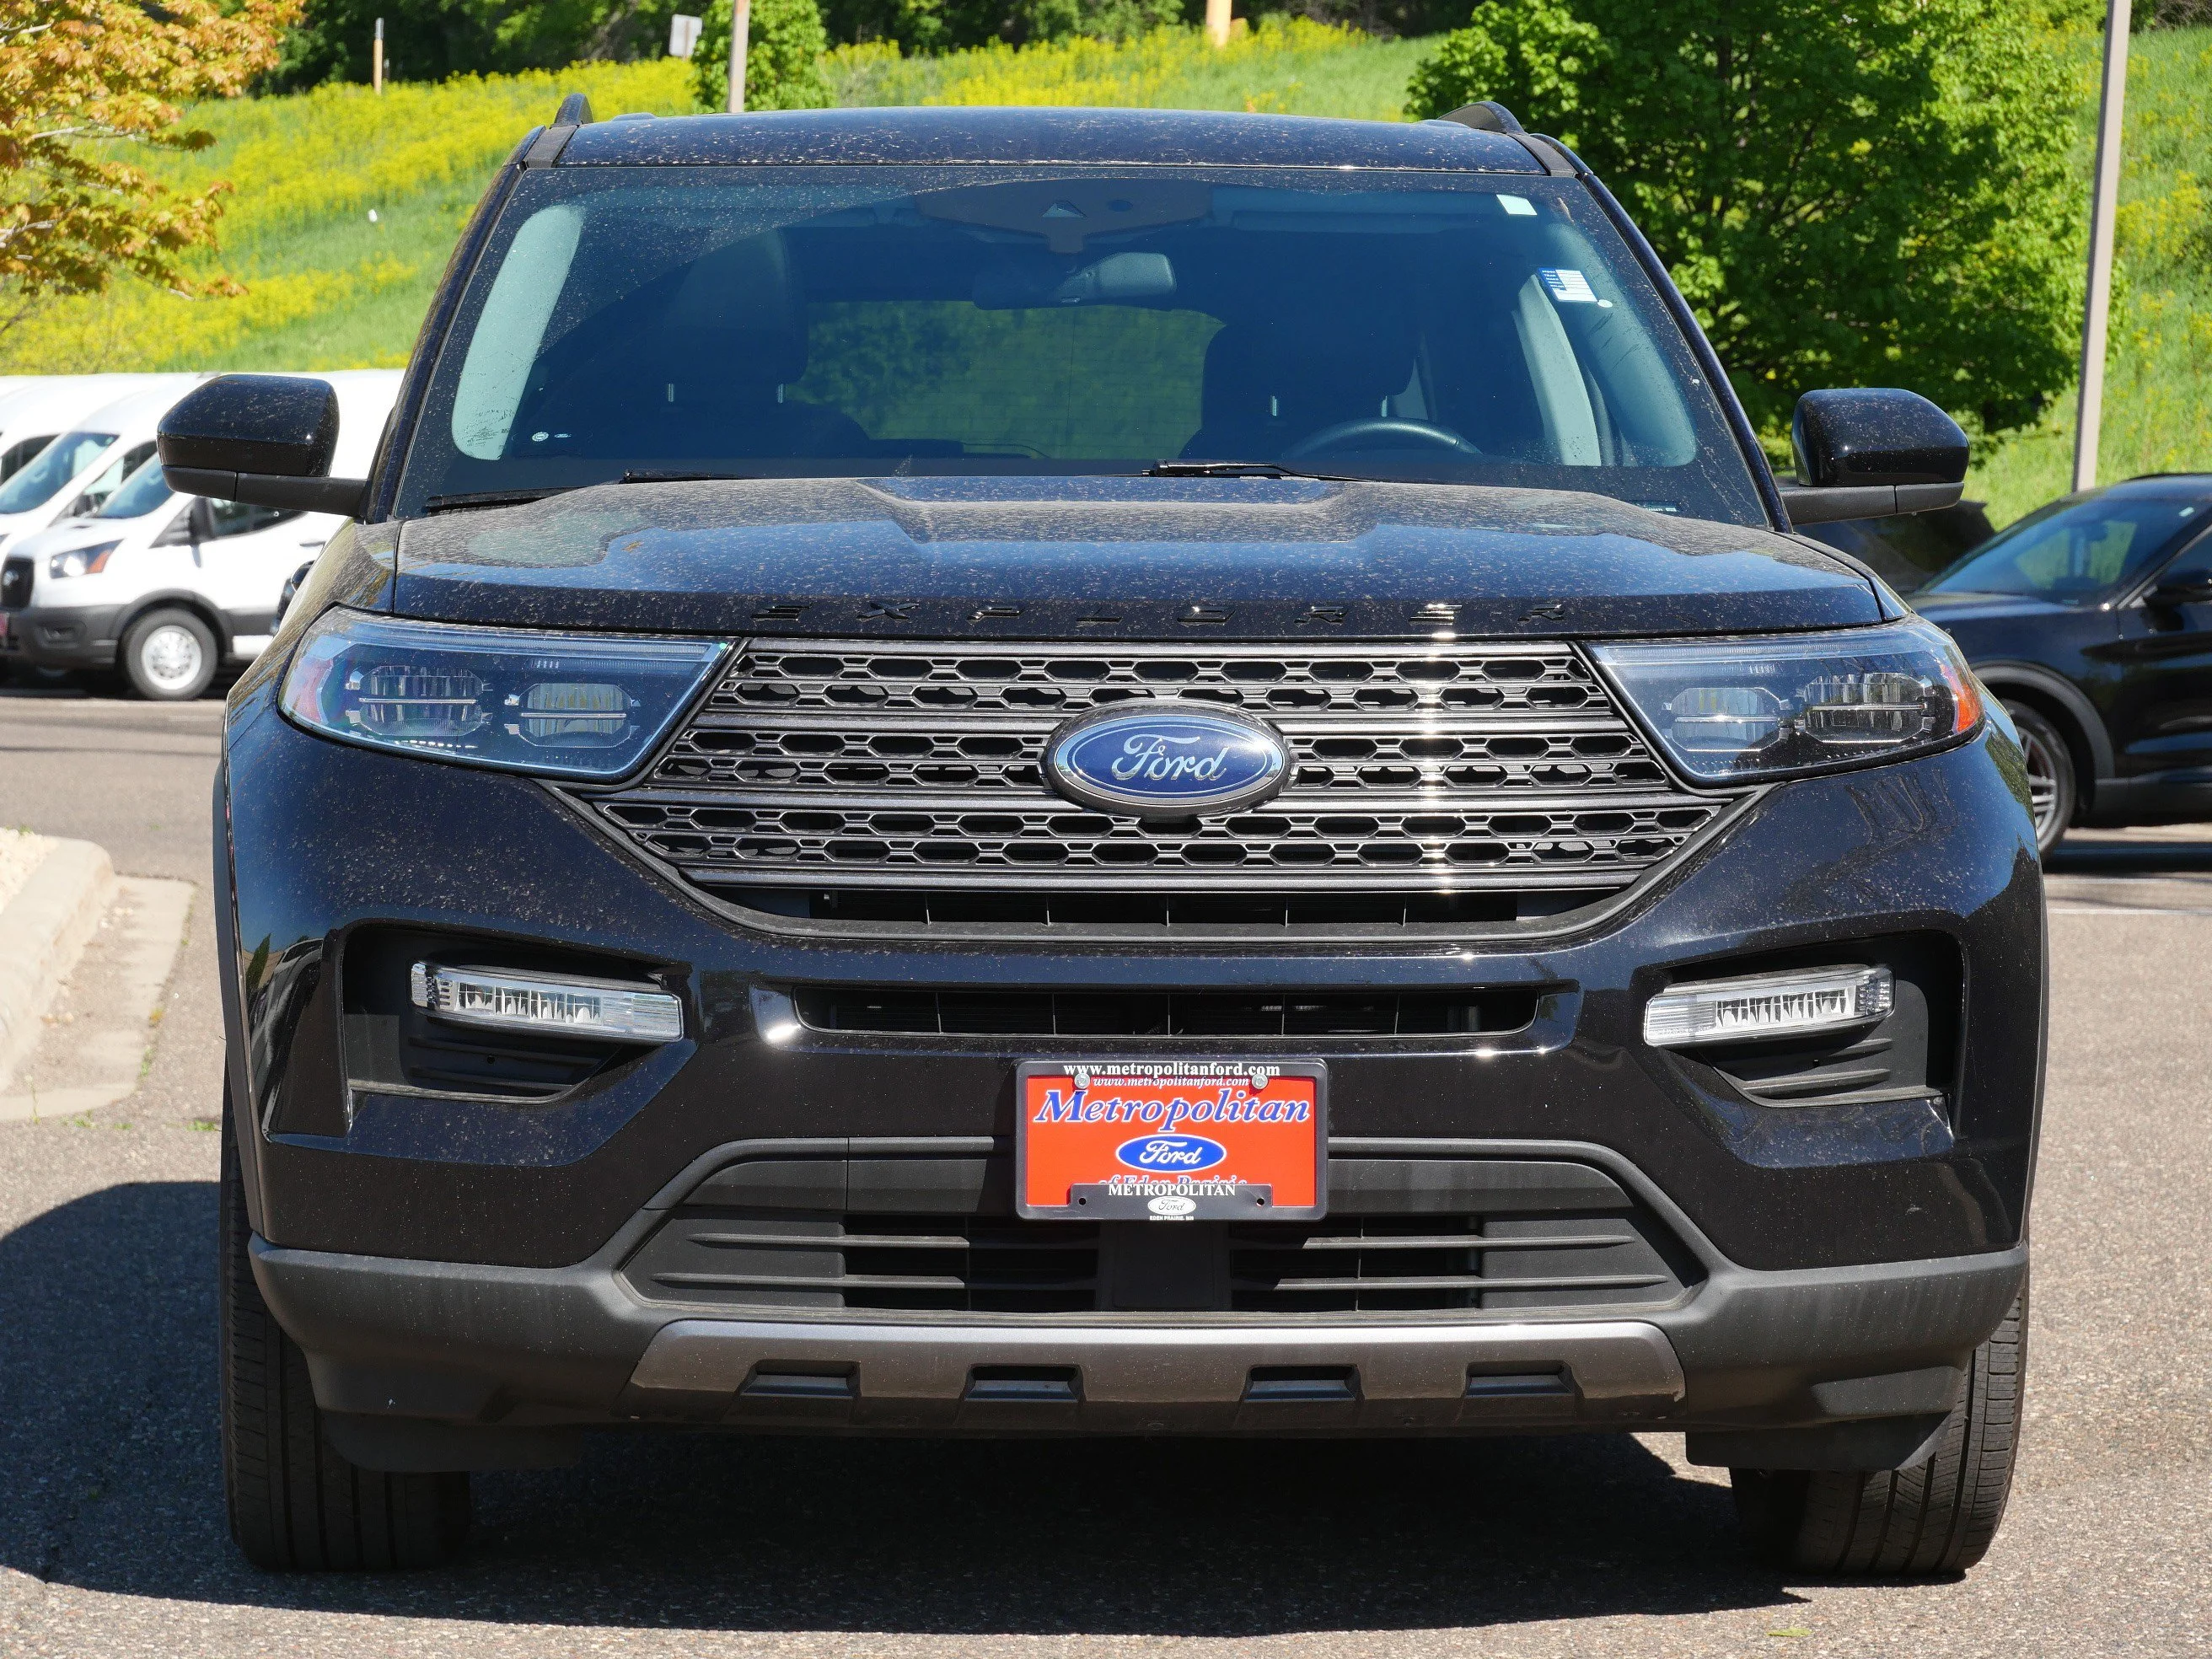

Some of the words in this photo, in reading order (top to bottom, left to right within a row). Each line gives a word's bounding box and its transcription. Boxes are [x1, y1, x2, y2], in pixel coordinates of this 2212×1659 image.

[1111, 733, 1229, 781] Ford
[1063, 1062, 1280, 1078] www.metropolitanford.com
[1093, 1076, 1249, 1088] www.metropolitanford.com
[1034, 1087, 1310, 1133] Metropolitan
[1139, 1140, 1203, 1164] Ford
[1109, 1184, 1236, 1196] METROPOLITAN
[1158, 1199, 1185, 1211] Ford
